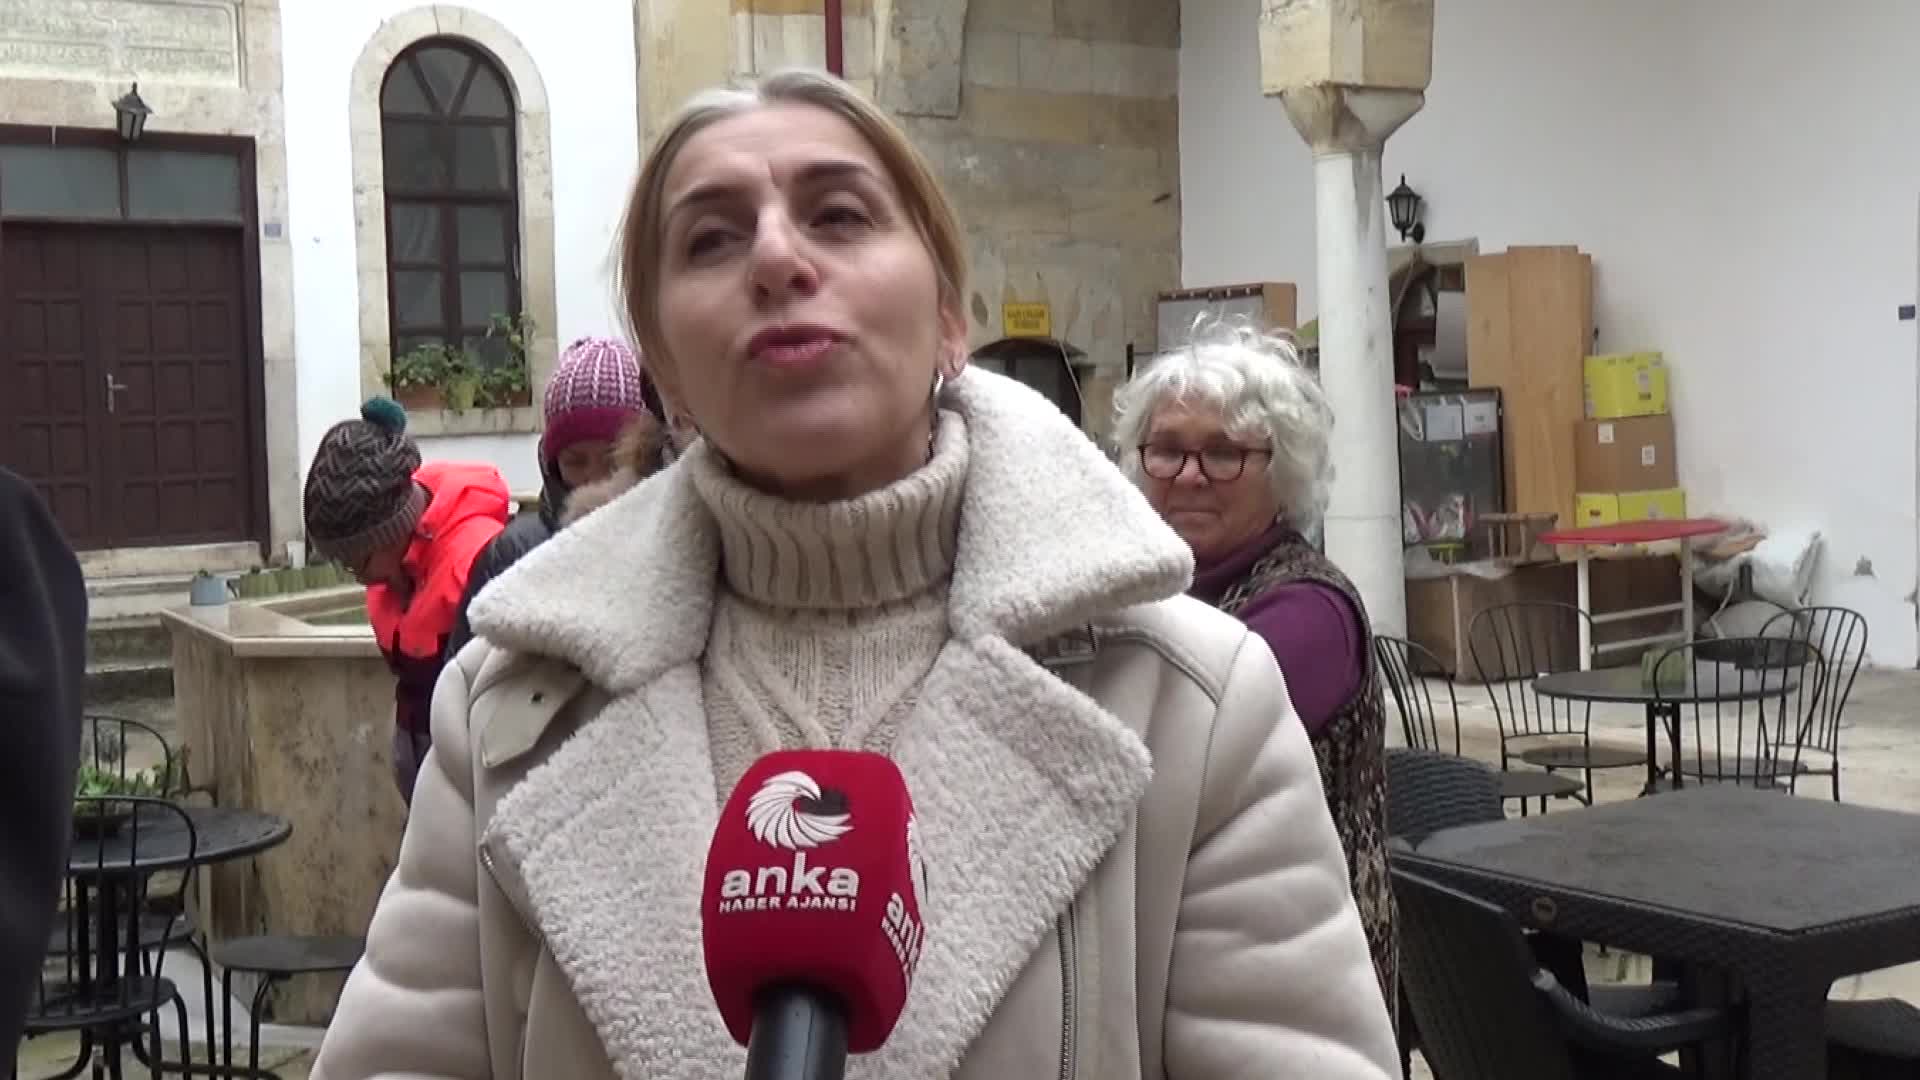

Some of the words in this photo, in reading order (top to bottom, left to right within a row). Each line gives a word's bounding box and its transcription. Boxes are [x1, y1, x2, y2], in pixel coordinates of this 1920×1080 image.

[721, 851, 859, 897] anka
[719, 896, 780, 912] HABER
[786, 896, 856, 912] AJANSI
